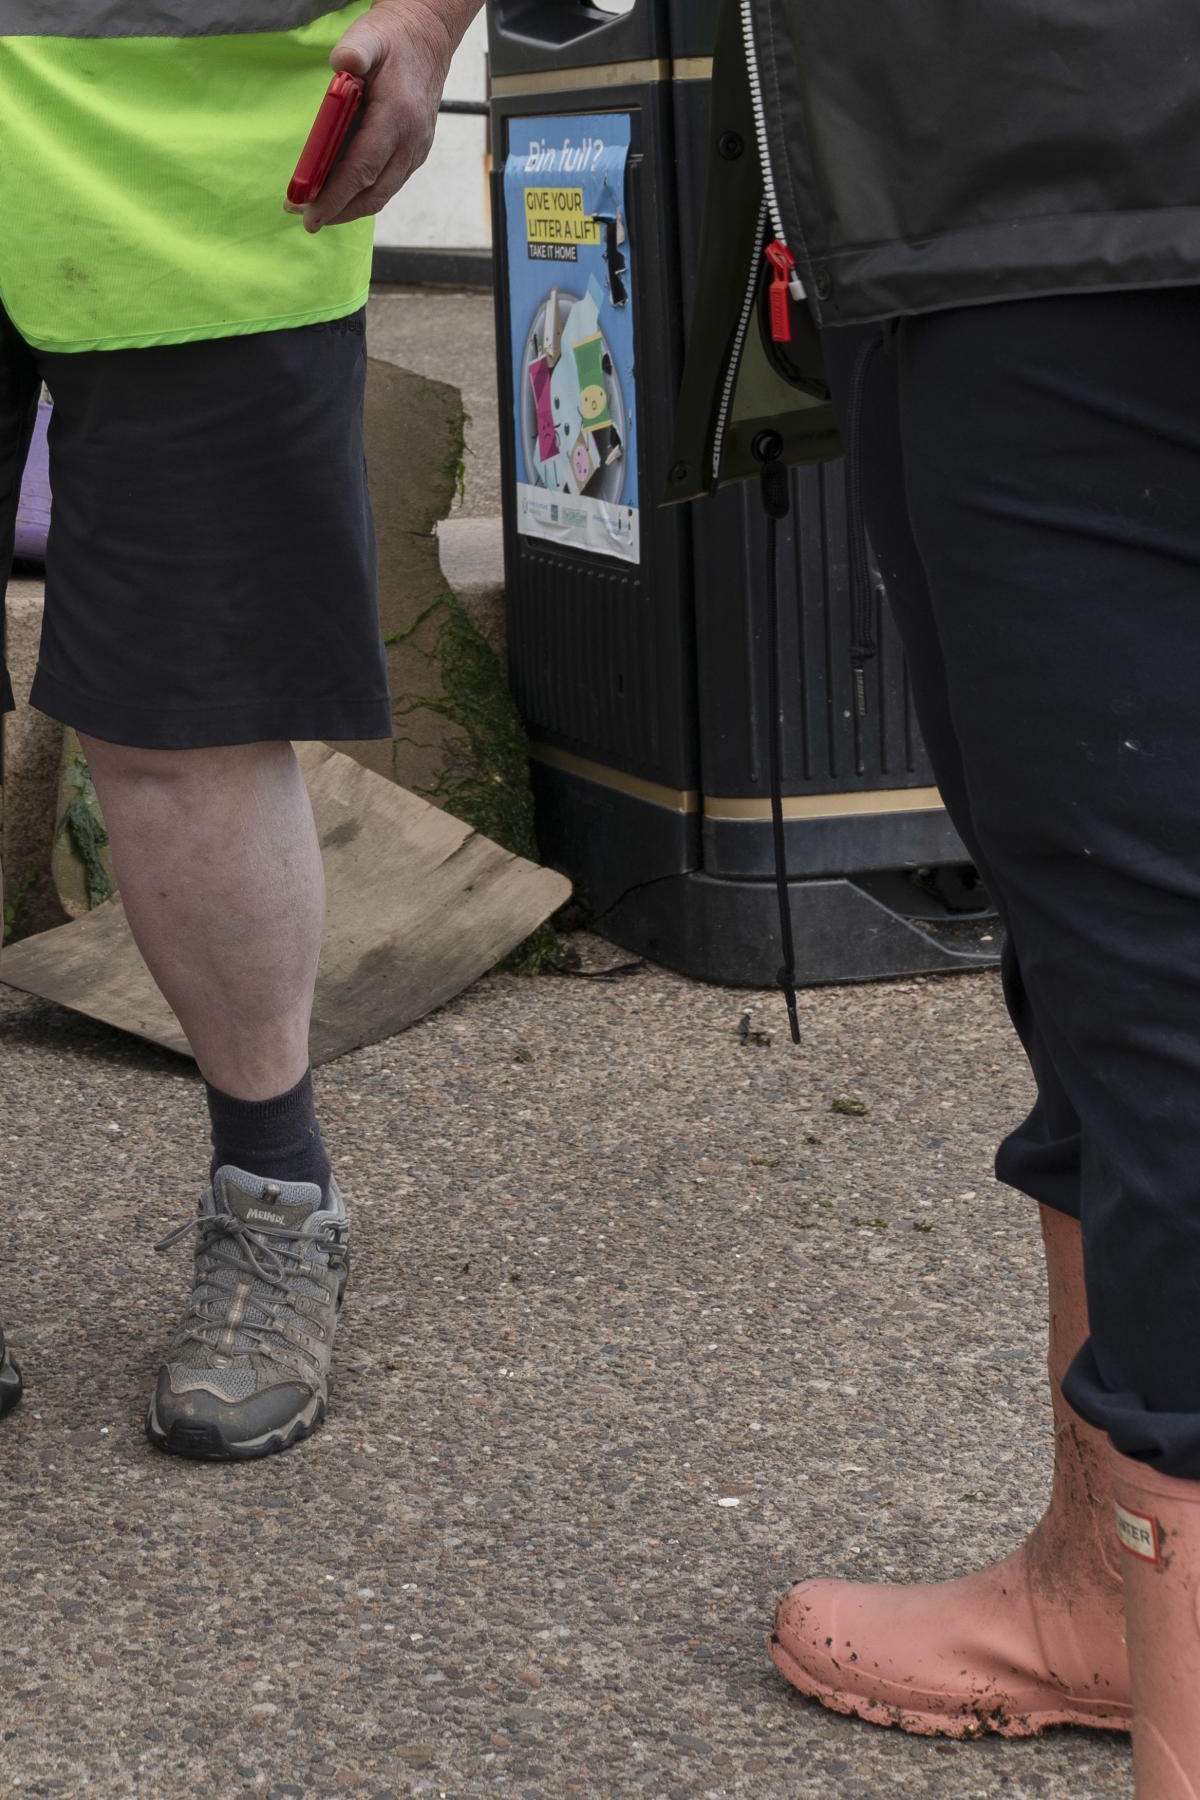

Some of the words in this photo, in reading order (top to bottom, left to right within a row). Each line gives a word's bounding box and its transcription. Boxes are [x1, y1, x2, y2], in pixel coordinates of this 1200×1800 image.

[524, 139, 556, 172] Bin
[559, 138, 604, 172] full?
[526, 192, 550, 211] GIVE
[552, 192, 582, 212] YOUR
[528, 218, 562, 238] LITTER
[564, 221, 573, 238] A
[575, 220, 599, 240] LIFT
[529, 244, 547, 258] TAKE
[547, 245, 554, 258] IT
[555, 245, 576, 260] HOME
[1119, 1517, 1151, 1546] NTER
